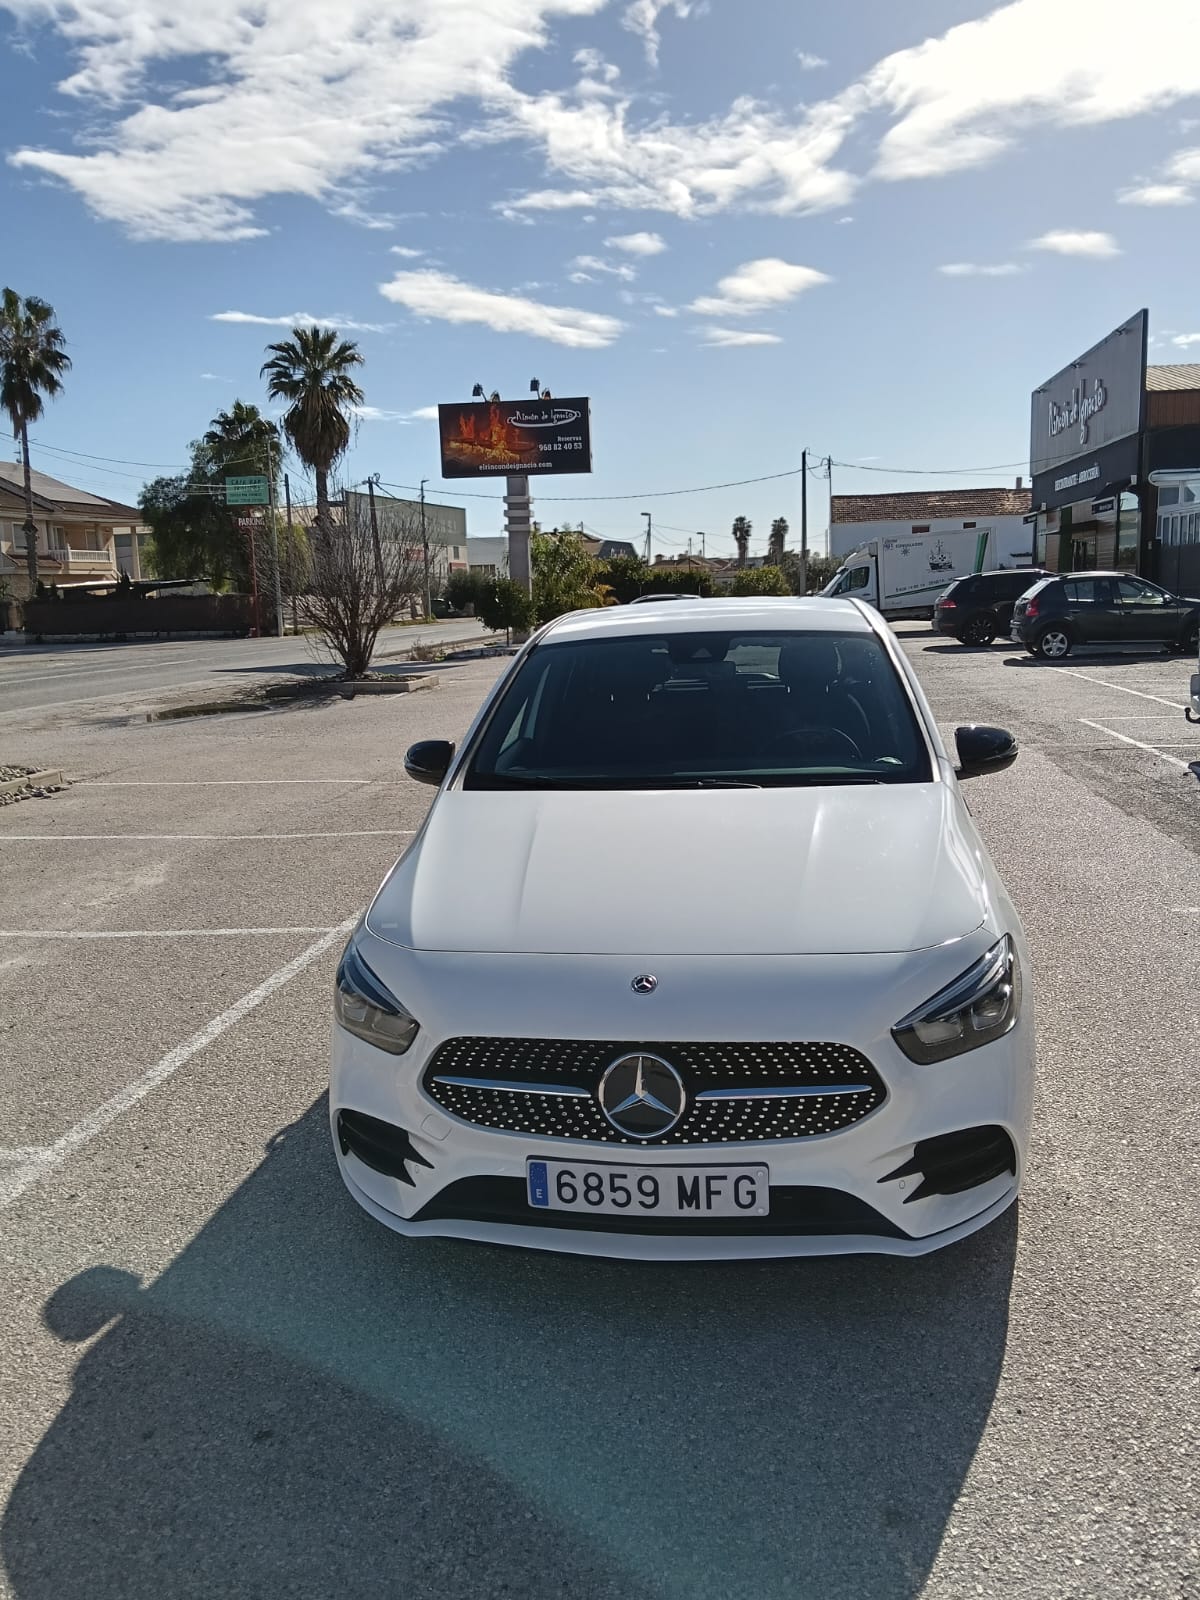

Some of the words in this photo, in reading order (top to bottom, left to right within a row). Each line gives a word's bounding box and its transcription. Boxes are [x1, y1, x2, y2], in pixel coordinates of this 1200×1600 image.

[1069, 388, 1078, 424] de
[541, 411, 549, 420] de
[479, 461, 553, 471] elrincondeignacio.com
[238, 517, 265, 527] PARKING
[535, 1189, 543, 1199] E
[555, 1169, 660, 1210] 6859
[676, 1174, 757, 1211] MFG
